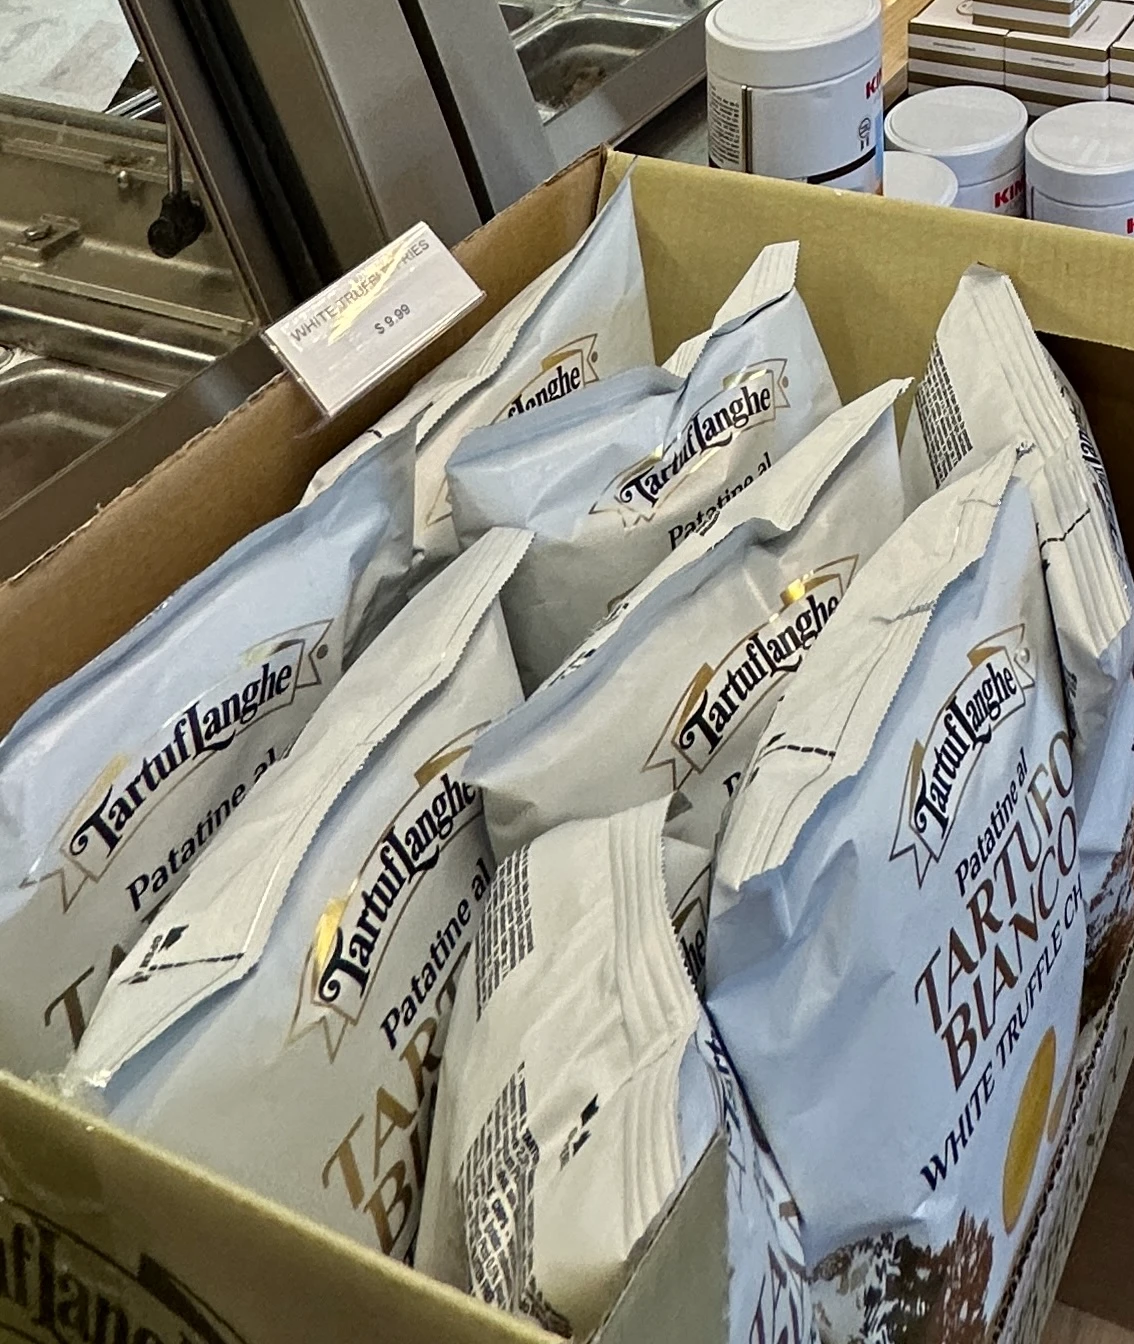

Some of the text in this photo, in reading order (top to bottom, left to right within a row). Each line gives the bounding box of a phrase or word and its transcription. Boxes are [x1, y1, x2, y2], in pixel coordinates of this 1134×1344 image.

[290, 305, 341, 342] WHITE
[125, 783, 247, 912] Patatine
[915, 730, 1075, 1034] TARTUFO
[955, 746, 1029, 898] Patatine al
[380, 857, 493, 1051] Patatine al
[941, 805, 1078, 1092] BIANCO
[918, 1051, 998, 1191] WHITE
[996, 925, 1064, 1071] TRUFFLE
